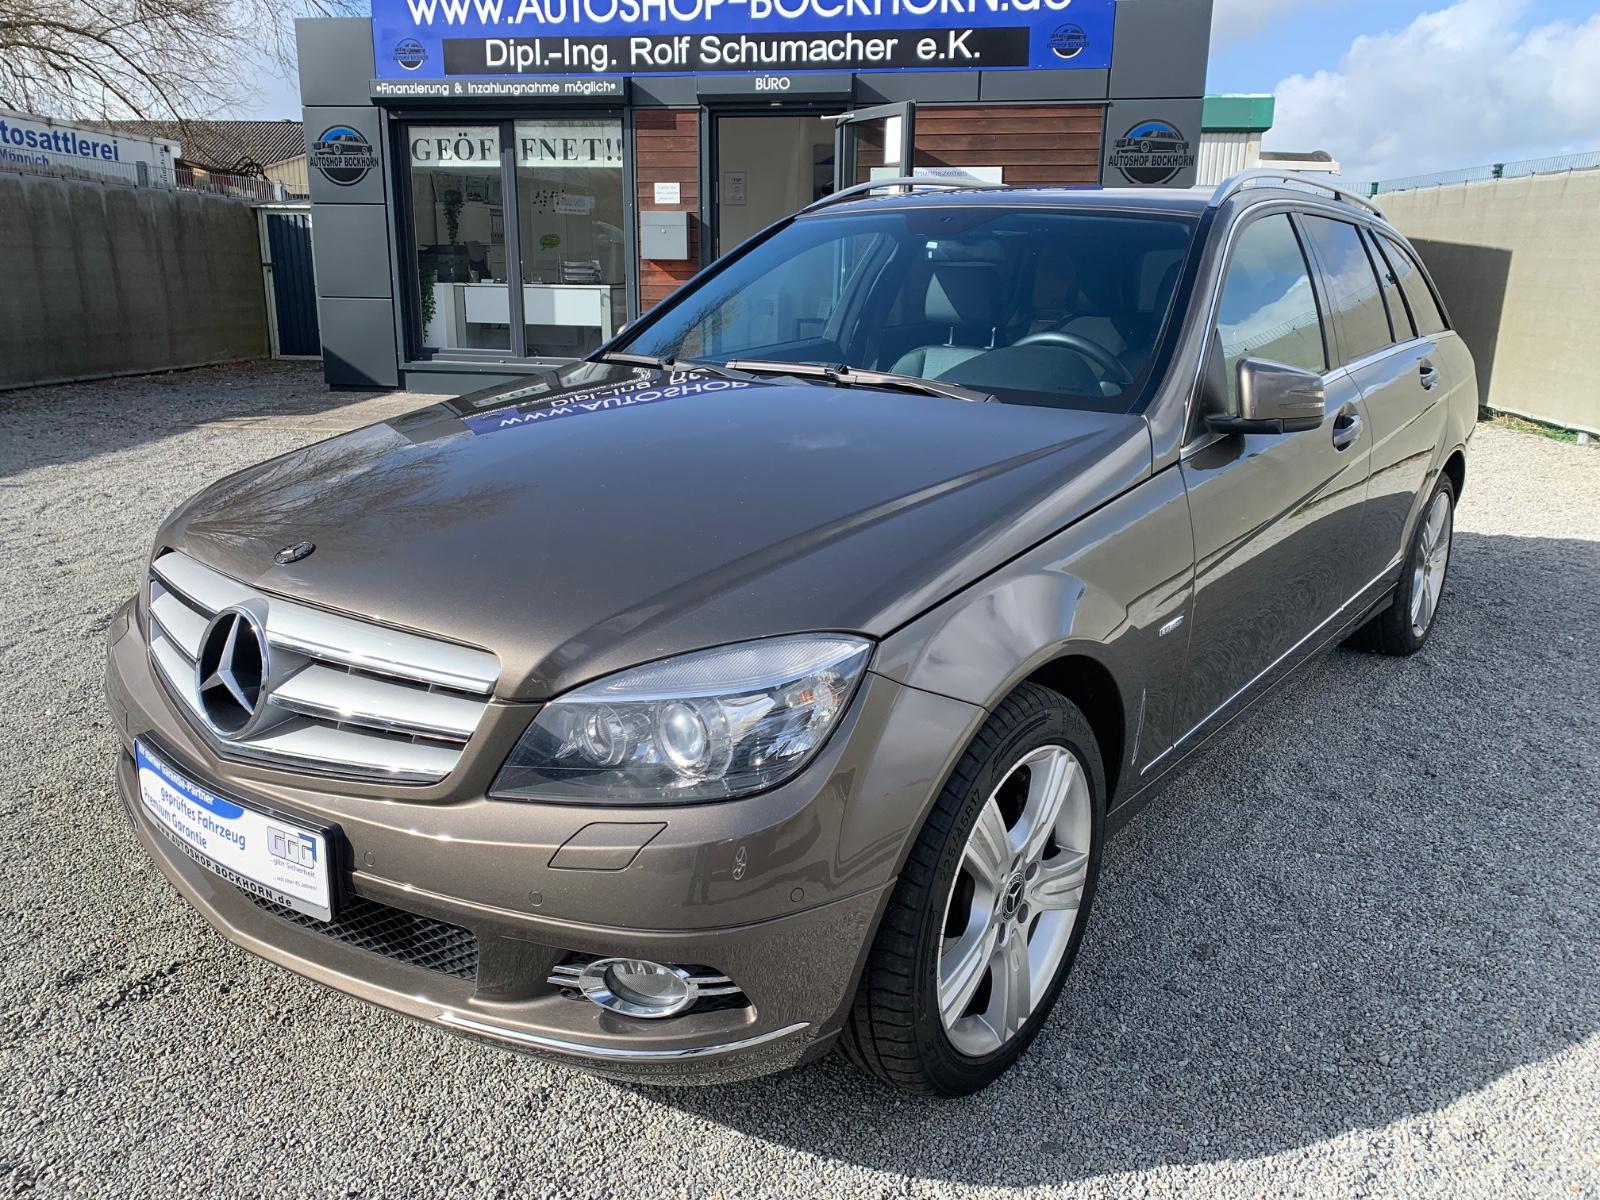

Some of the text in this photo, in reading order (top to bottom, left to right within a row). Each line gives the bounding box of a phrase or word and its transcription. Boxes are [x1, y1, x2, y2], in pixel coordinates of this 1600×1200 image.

[485, 29, 981, 72] Dipl.-Ing. Rolf Schumacher e.K.
[454, 82, 463, 94] &
[468, 81, 560, 96] Inzahlungnahme
[755, 74, 791, 90] BÜRO
[411, 132, 623, 161] GEÖF FNET!!
[1108, 155, 1194, 167] AUTOSHOP BOCKHORN
[310, 156, 379, 167] AUTOSHOP BOCKHORN
[143, 786, 208, 850] Premium Garantie
[161, 787, 246, 851] geprüftes Fahrzeug
[939, 787, 981, 882] 225/45R17
